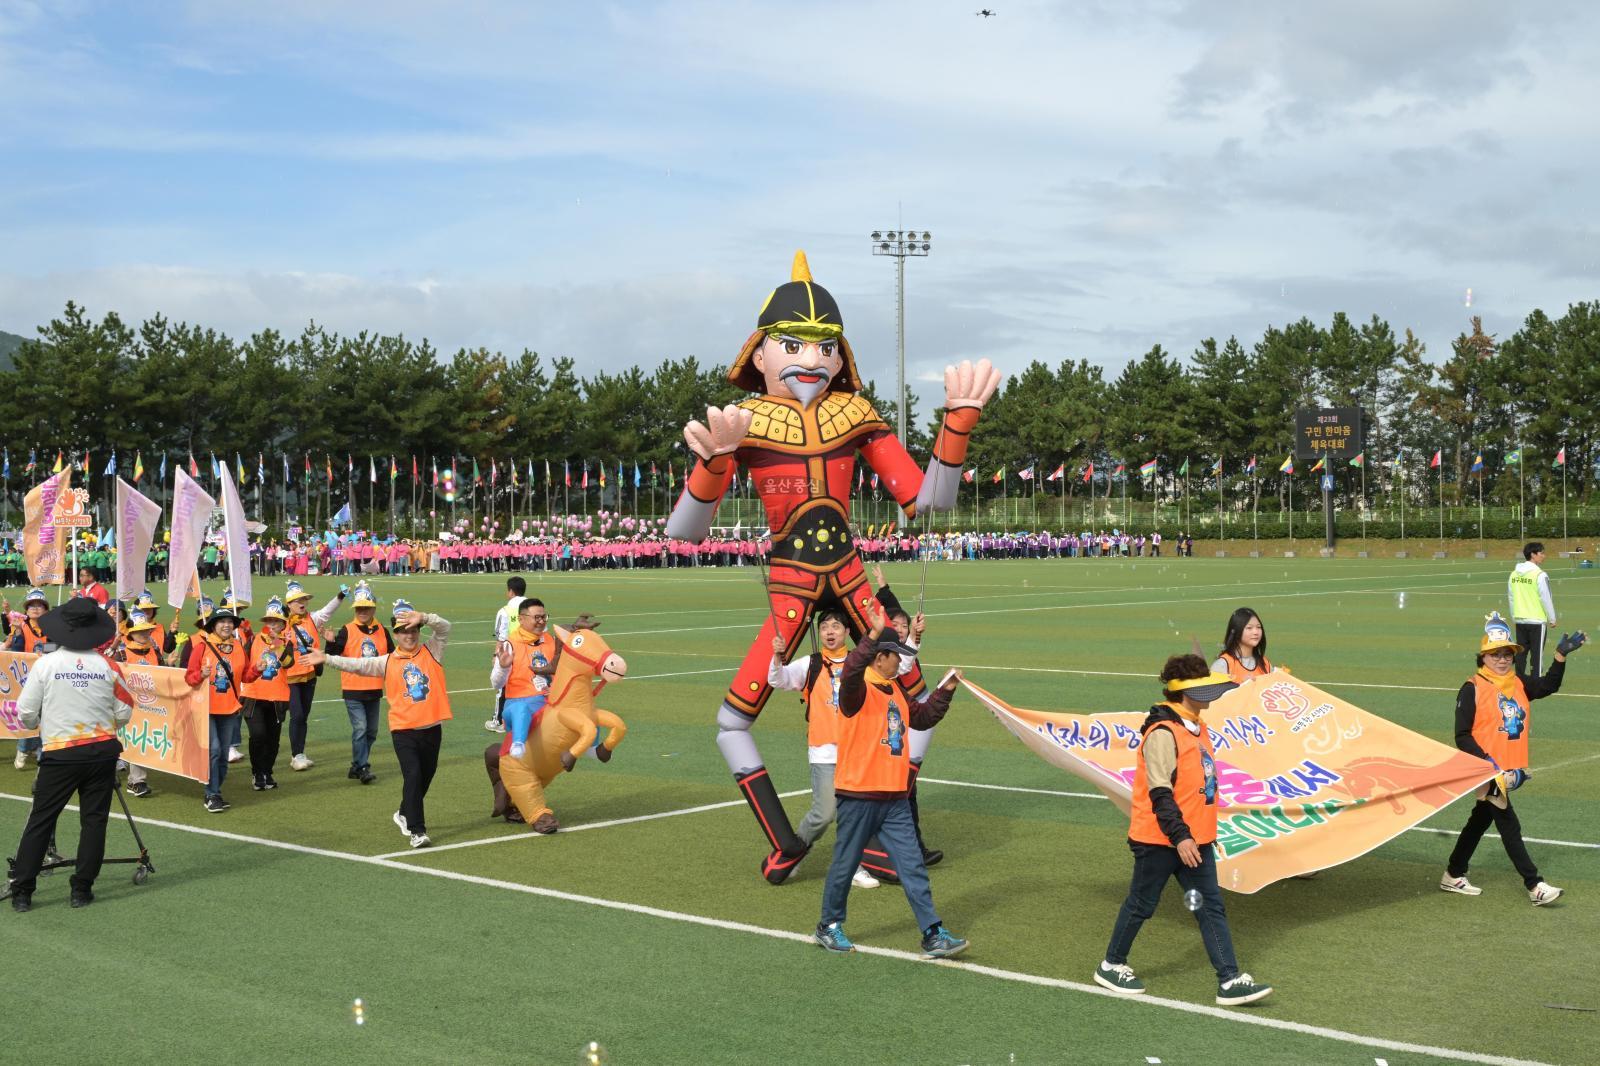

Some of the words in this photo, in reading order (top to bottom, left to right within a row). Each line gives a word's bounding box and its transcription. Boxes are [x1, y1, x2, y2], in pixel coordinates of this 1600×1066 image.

[1304, 426, 1322, 437] 구민
[1325, 425, 1352, 437] 한마음
[1311, 439, 1345, 450] 체육대회
[1323, 477, 1331, 488] A
[54, 672, 105, 680] GYEONGNAM
